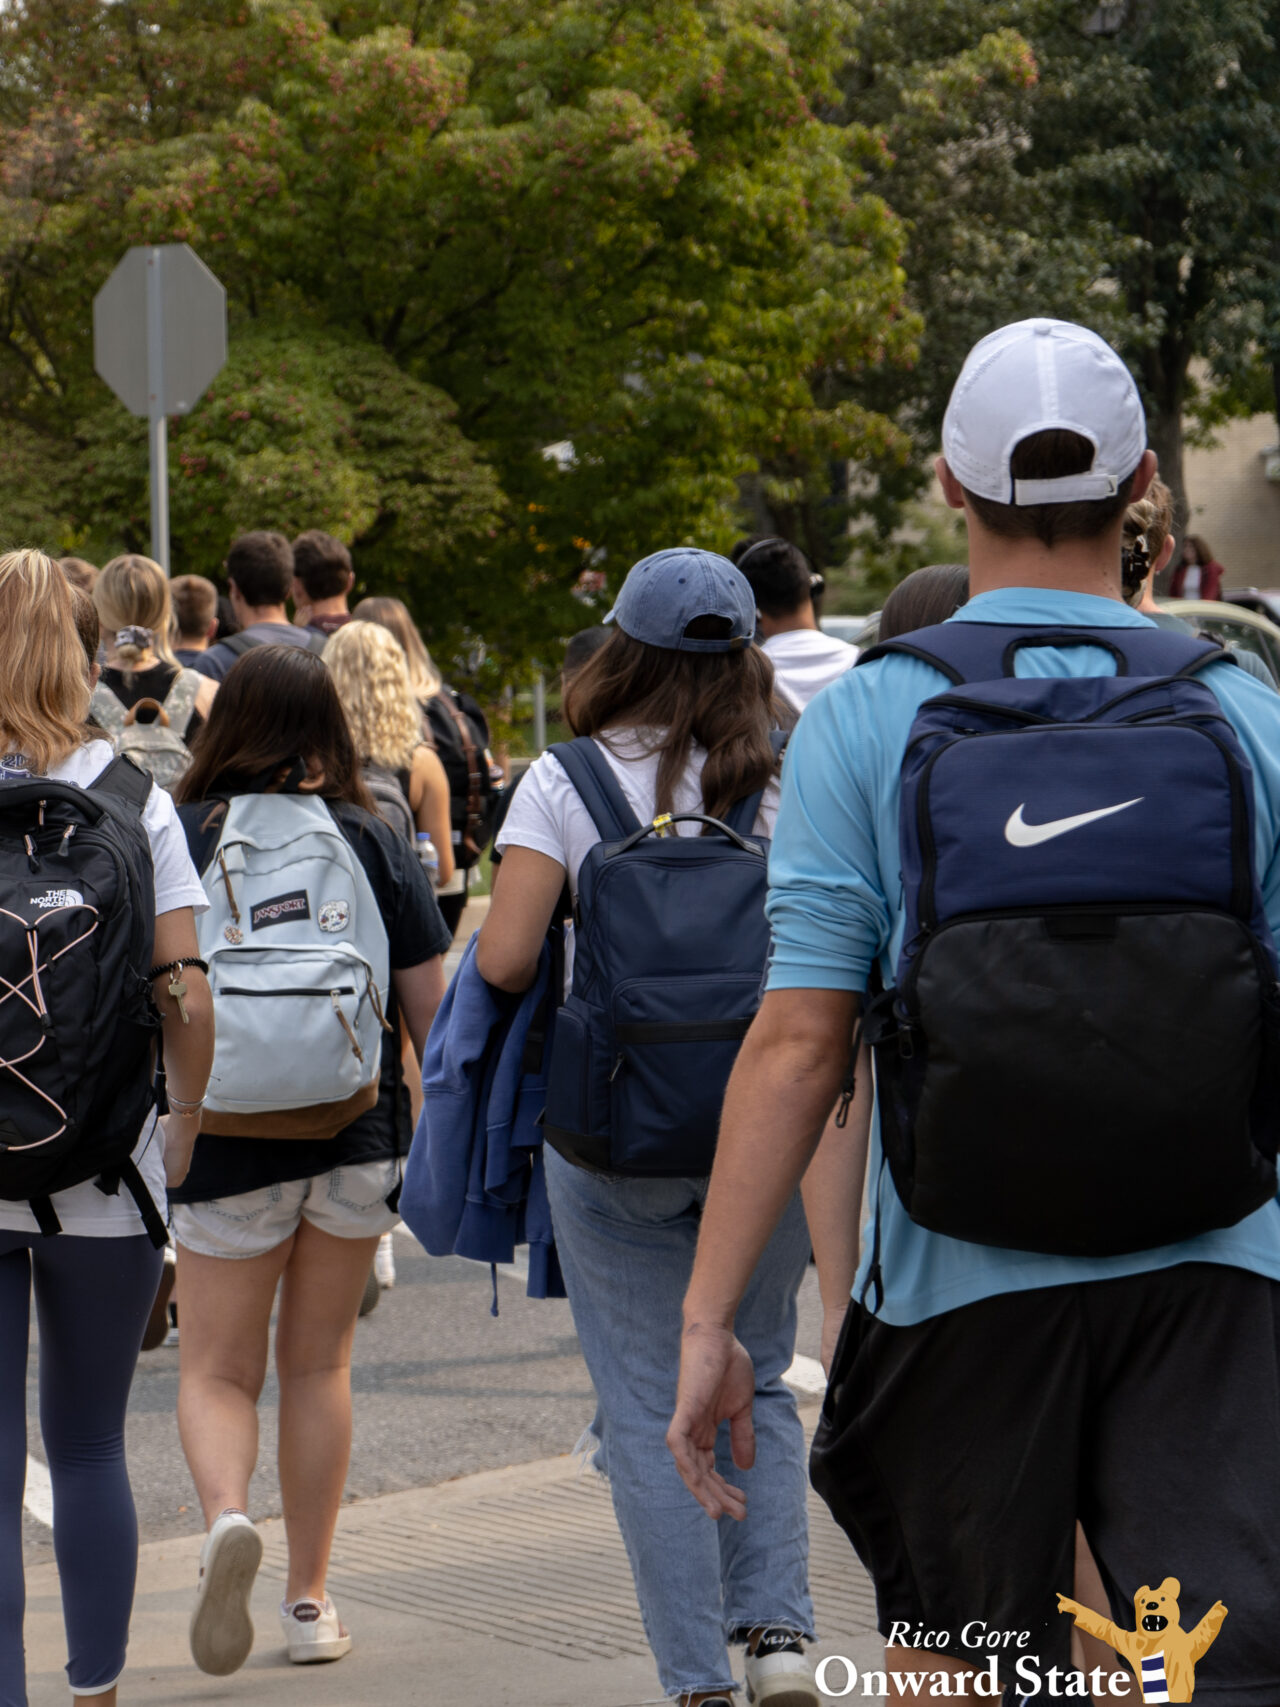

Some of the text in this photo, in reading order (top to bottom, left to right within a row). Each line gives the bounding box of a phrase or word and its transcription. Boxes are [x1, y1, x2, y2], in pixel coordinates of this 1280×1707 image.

[46, 890, 67, 898] THE
[30, 896, 66, 904] NORTH
[253, 898, 306, 924] JANSPORT
[764, 1634, 792, 1646] VEJA
